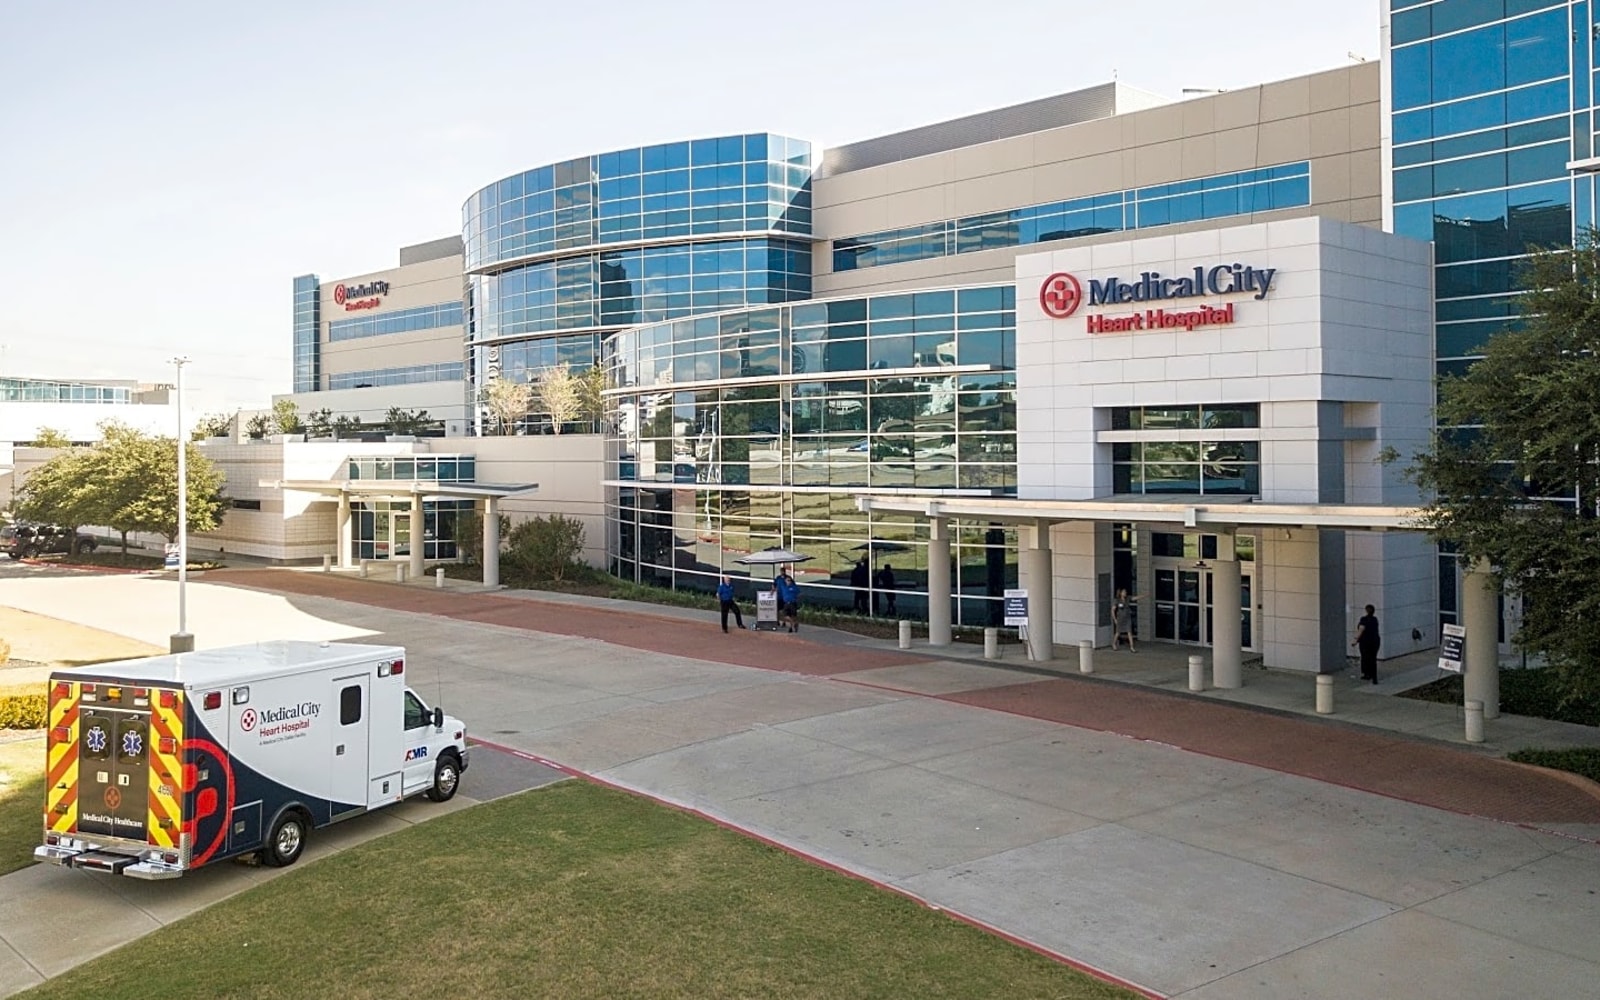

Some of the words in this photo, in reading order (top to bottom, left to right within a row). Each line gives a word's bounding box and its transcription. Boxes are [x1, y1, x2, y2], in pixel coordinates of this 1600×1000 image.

[374, 280, 389, 296] City
[1088, 267, 1205, 306] Medical
[1207, 263, 1276, 300] City
[1087, 313, 1143, 334] Heart
[1146, 303, 1234, 331] Hospital
[260, 704, 300, 724] Medical
[301, 702, 321, 717] City
[260, 725, 280, 737] Heart
[281, 719, 310, 733] Hospital
[405, 746, 427, 761] AMR
[82, 812, 103, 823] Medical
[103, 815, 114, 826] City
[114, 817, 143, 828] Healthcare
